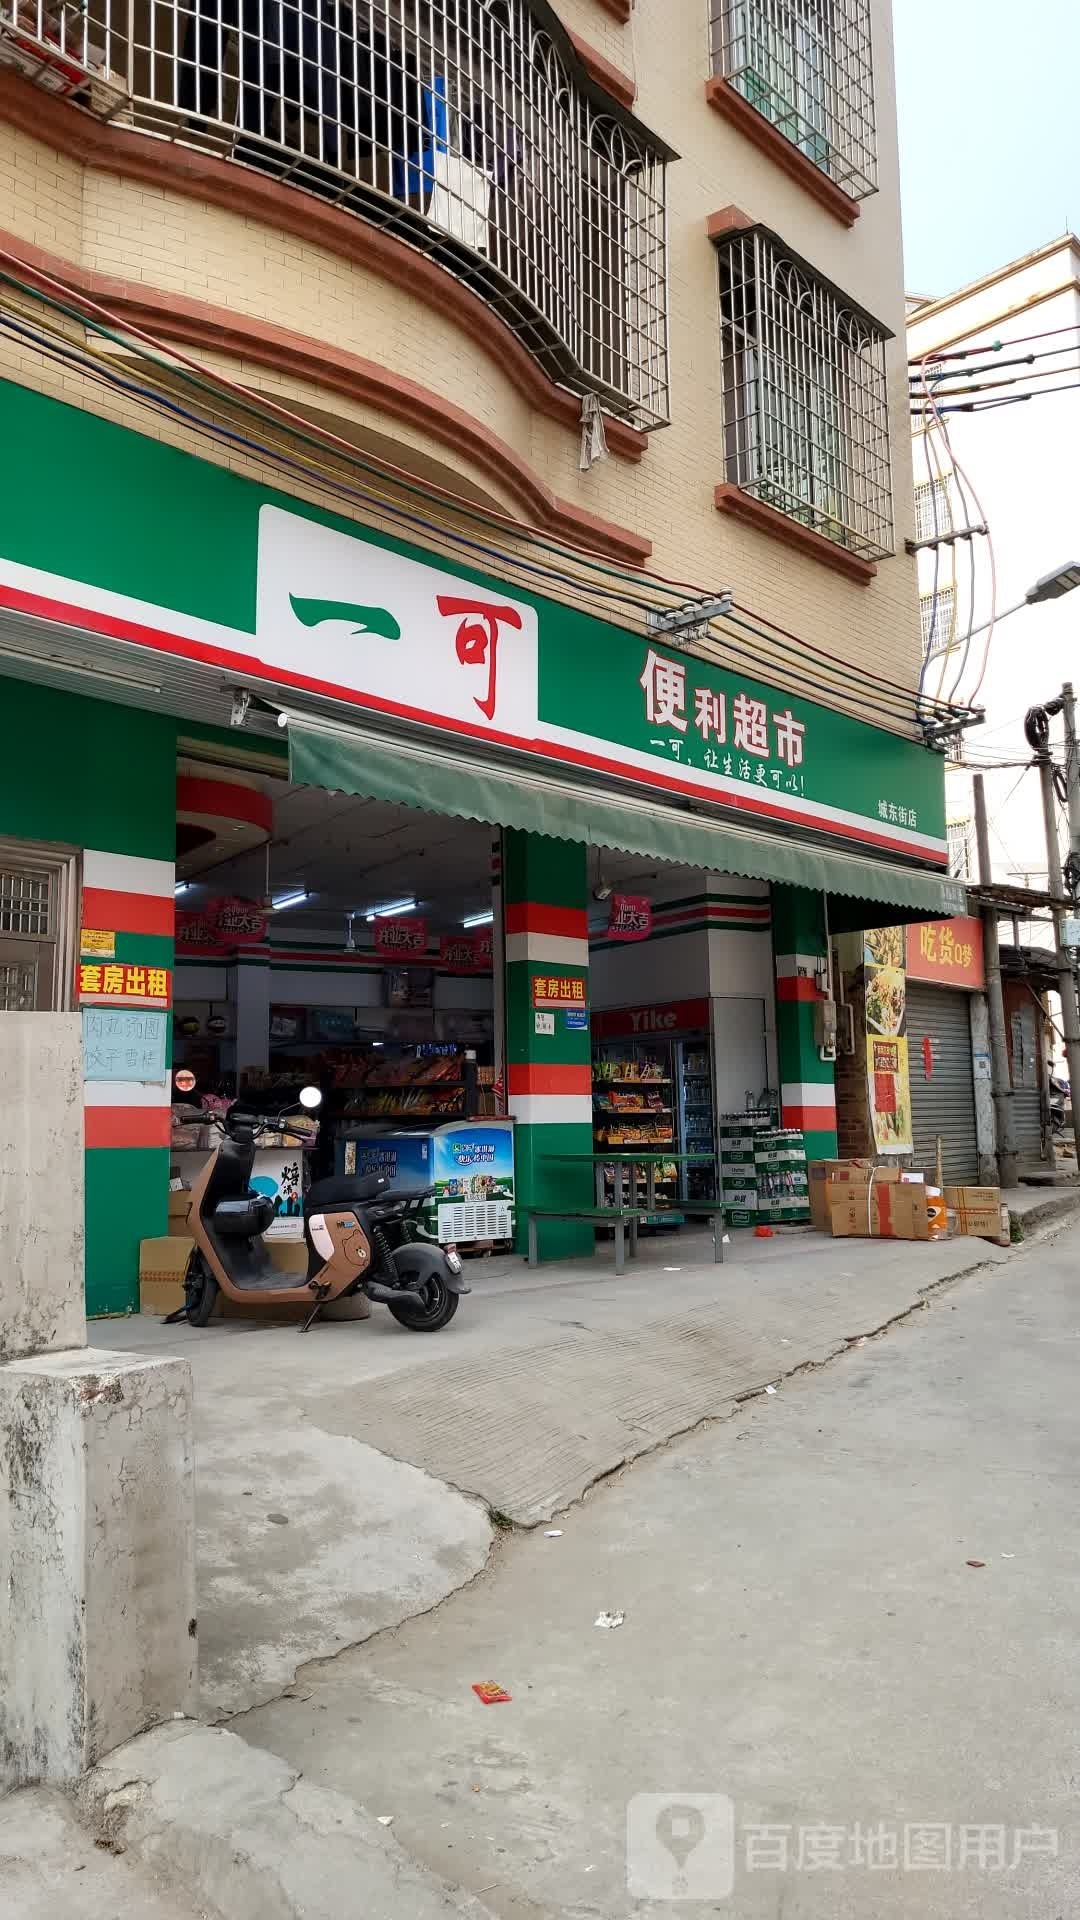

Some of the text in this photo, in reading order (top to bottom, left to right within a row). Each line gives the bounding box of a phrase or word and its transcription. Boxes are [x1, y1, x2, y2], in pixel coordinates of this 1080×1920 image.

[288, 591, 522, 721] 一可
[640, 649, 806, 768] 便利超市
[877, 799, 918, 829] 城东街店
[80, 964, 168, 997] 套房出租
[534, 978, 584, 999] 套房出租
[630, 1010, 677, 1033] Yike
